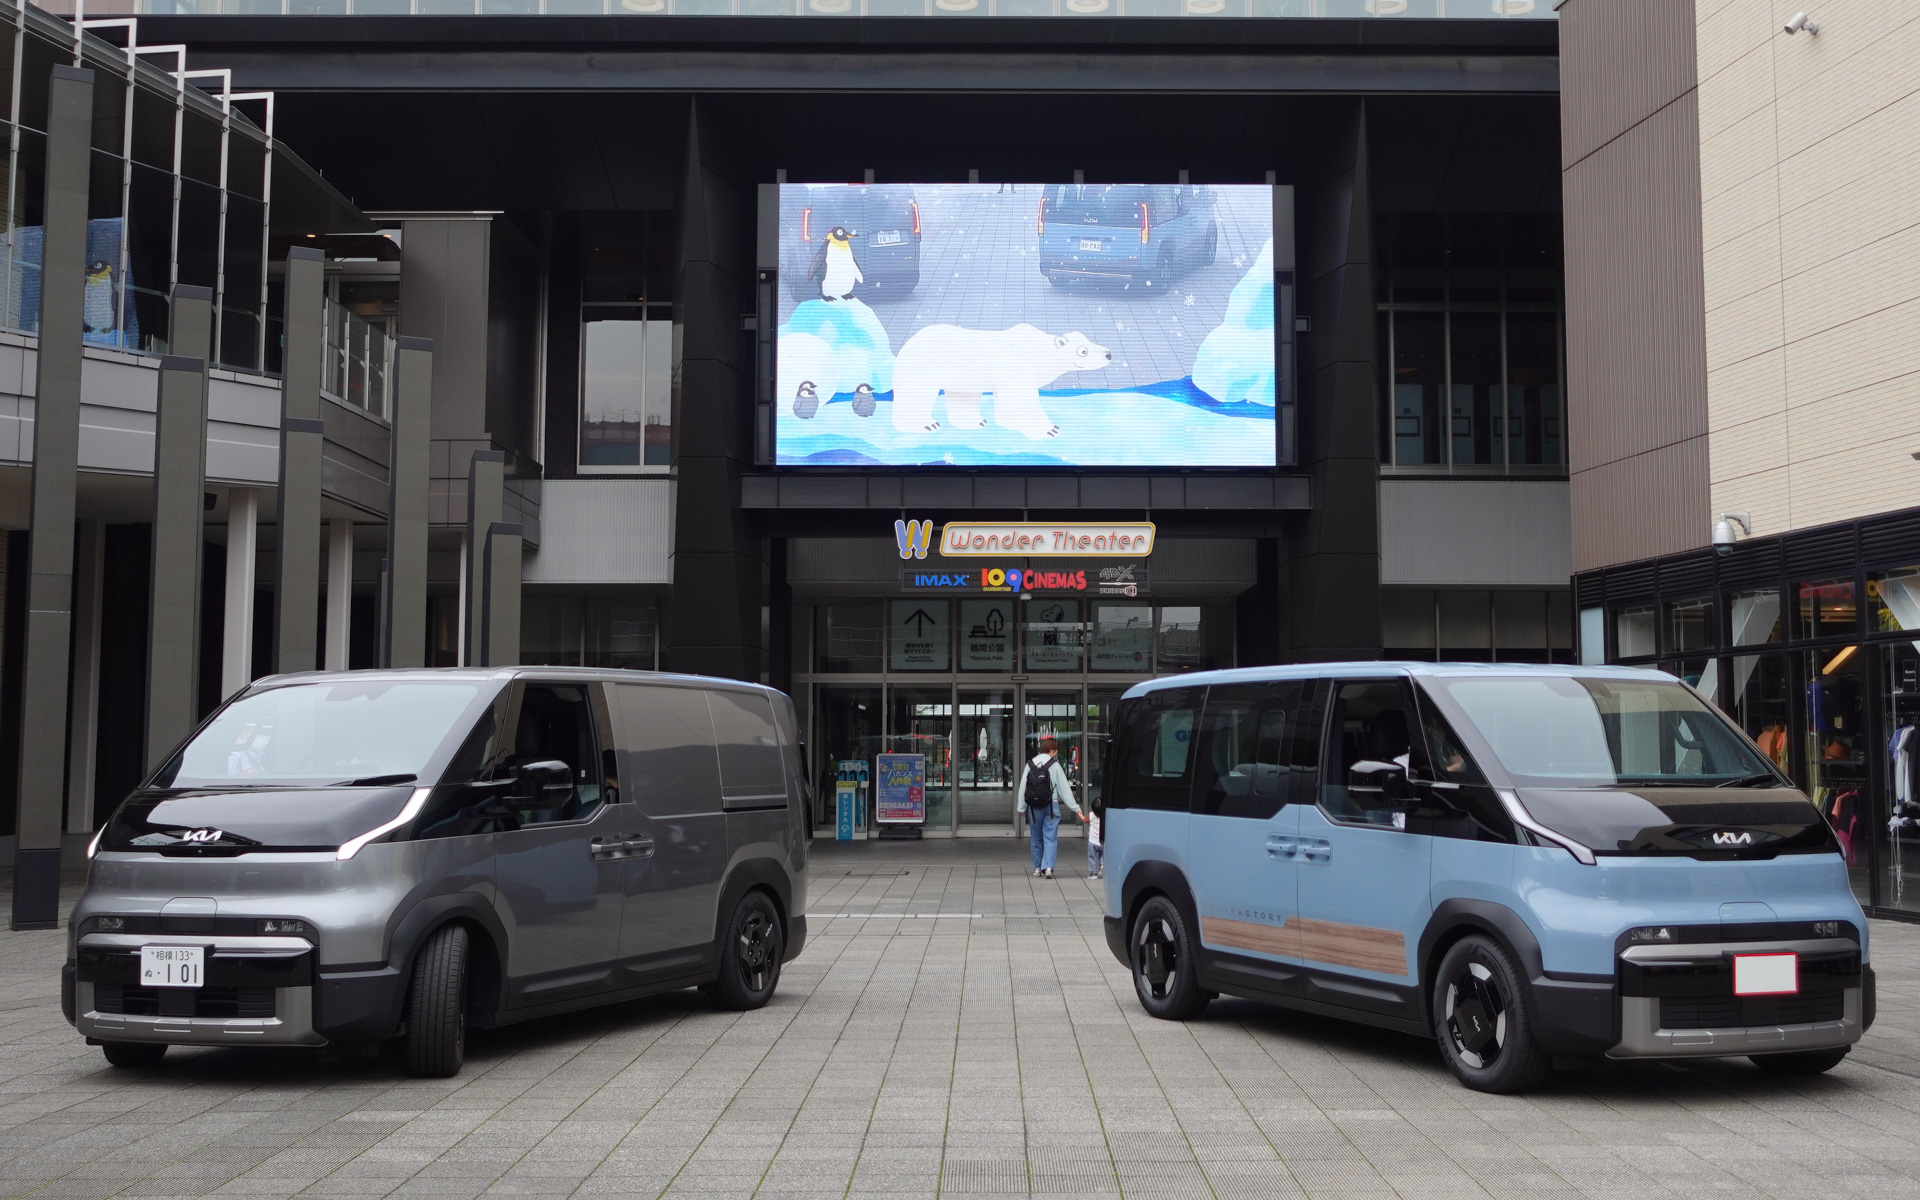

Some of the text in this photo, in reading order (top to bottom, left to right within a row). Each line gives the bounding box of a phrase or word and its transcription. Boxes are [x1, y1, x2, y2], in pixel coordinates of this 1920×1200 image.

[950, 530, 1146, 549] Wonder Theater
[915, 574, 968, 587] IMAX
[981, 568, 1087, 593] 109 CINEMAS
